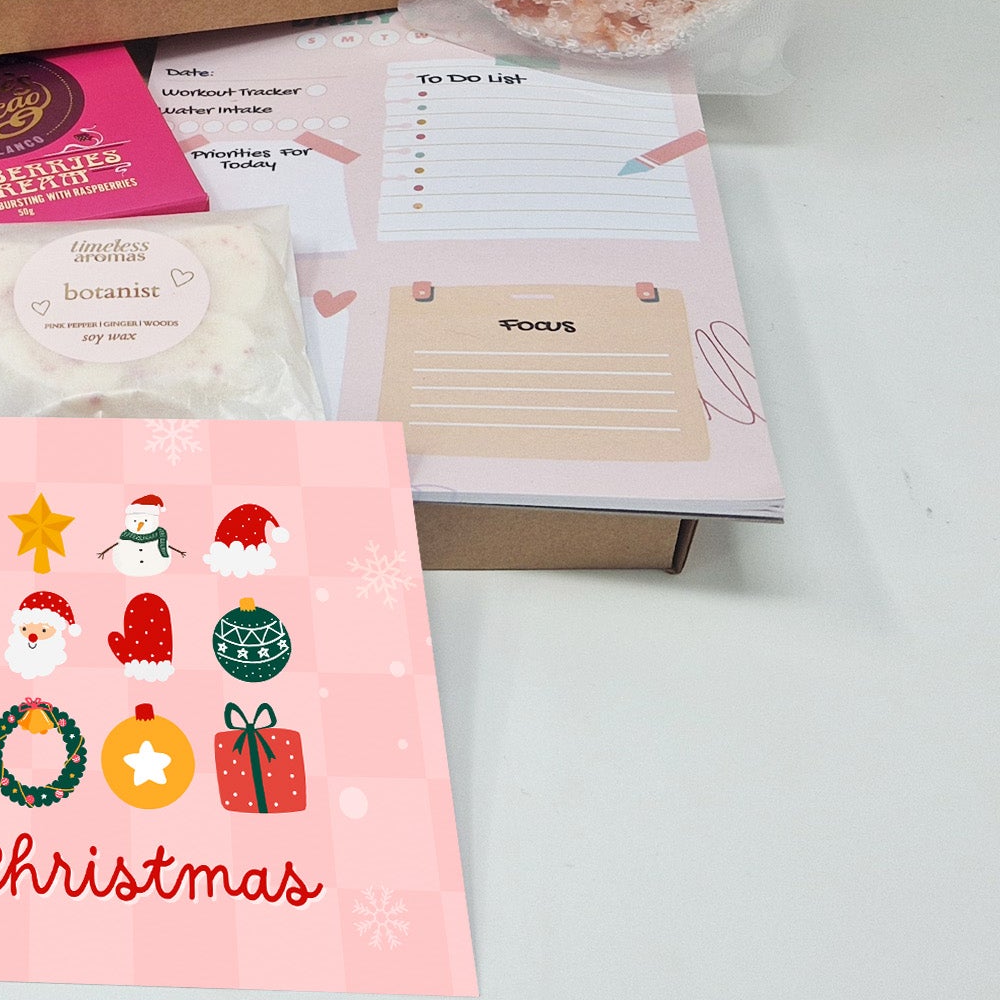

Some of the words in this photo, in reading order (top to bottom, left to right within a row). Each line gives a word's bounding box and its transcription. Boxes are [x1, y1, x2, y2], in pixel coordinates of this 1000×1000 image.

[165, 68, 214, 77] Date:
[416, 74, 443, 84] To
[447, 74, 481, 83] Do
[488, 73, 527, 84] List
[161, 87, 236, 97] Workout
[238, 87, 302, 96] Tracker
[218, 105, 273, 114] Intake
[191, 148, 271, 159] Priorities
[280, 147, 313, 157] For
[219, 160, 277, 171] Today
[46, 189, 72, 202] WITH
[73, 177, 138, 198] RASPBERRIES
[18, 207, 35, 217] 50g
[70, 239, 150, 253] timeless
[74, 252, 146, 263] aromas
[64, 282, 160, 301] botanist
[498, 319, 576, 333] Focus
[81, 333, 104, 345] soy
[108, 332, 137, 341] wax
